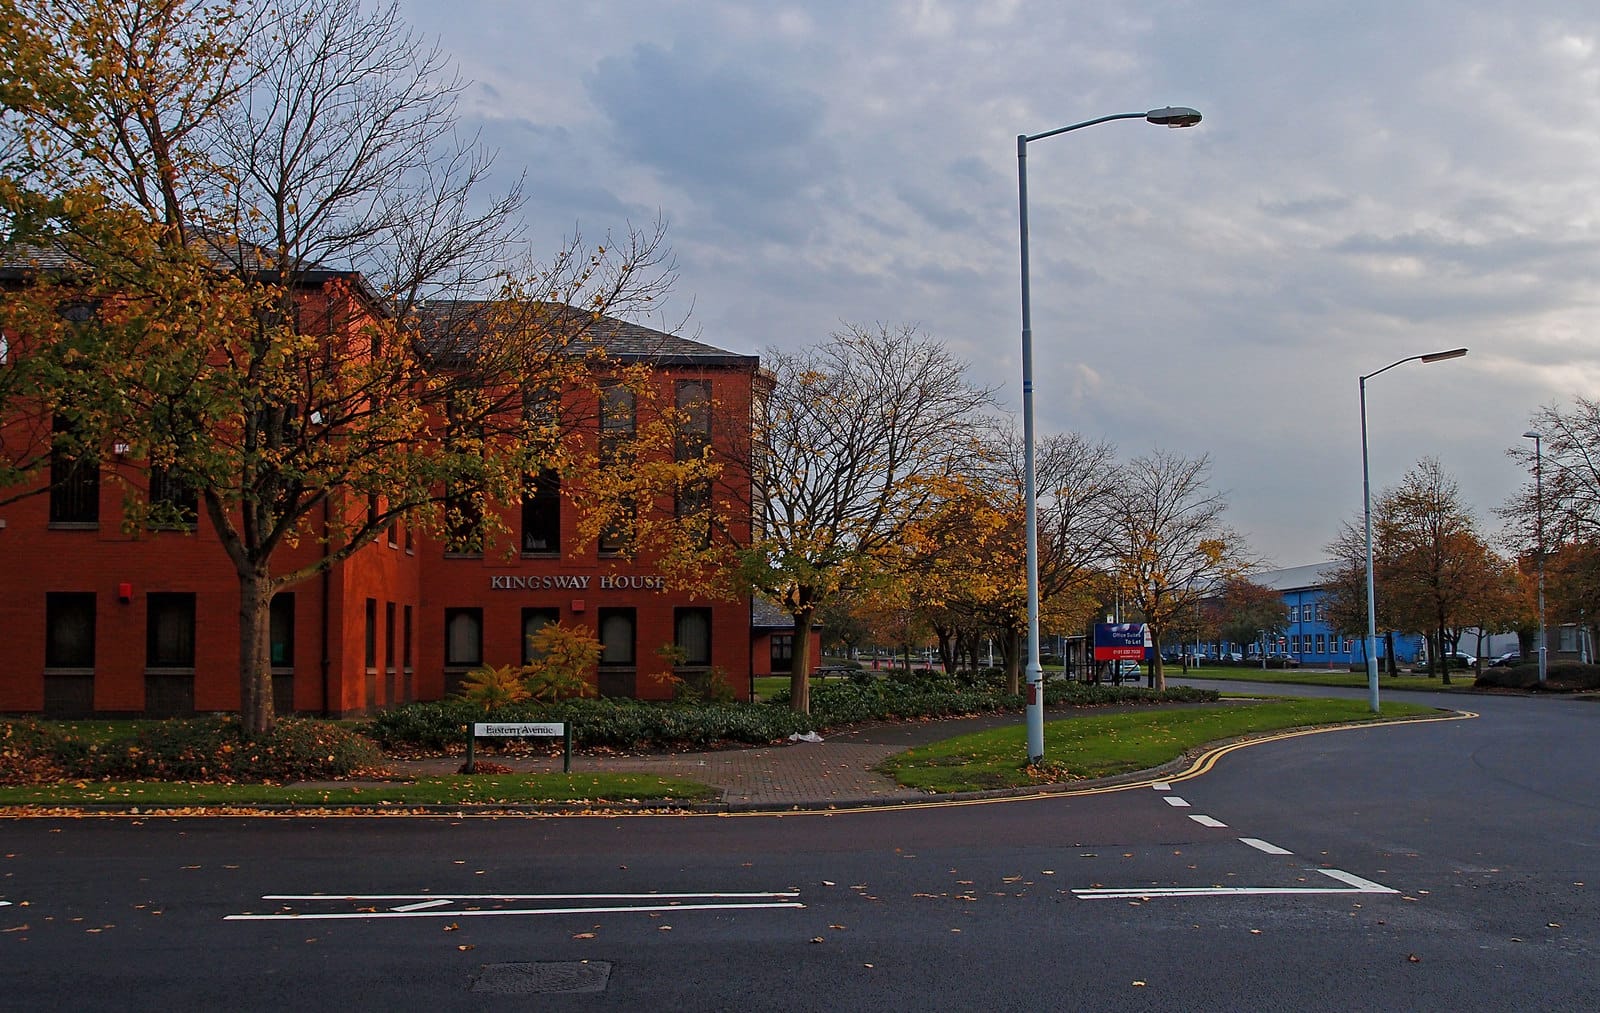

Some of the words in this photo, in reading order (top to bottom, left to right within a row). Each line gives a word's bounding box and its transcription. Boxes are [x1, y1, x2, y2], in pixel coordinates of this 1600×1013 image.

[491, 575, 591, 589] KINGSWAY
[601, 575, 666, 589] HOUSE
[486, 725, 520, 735] Eastern
[521, 725, 553, 734] Avenue
